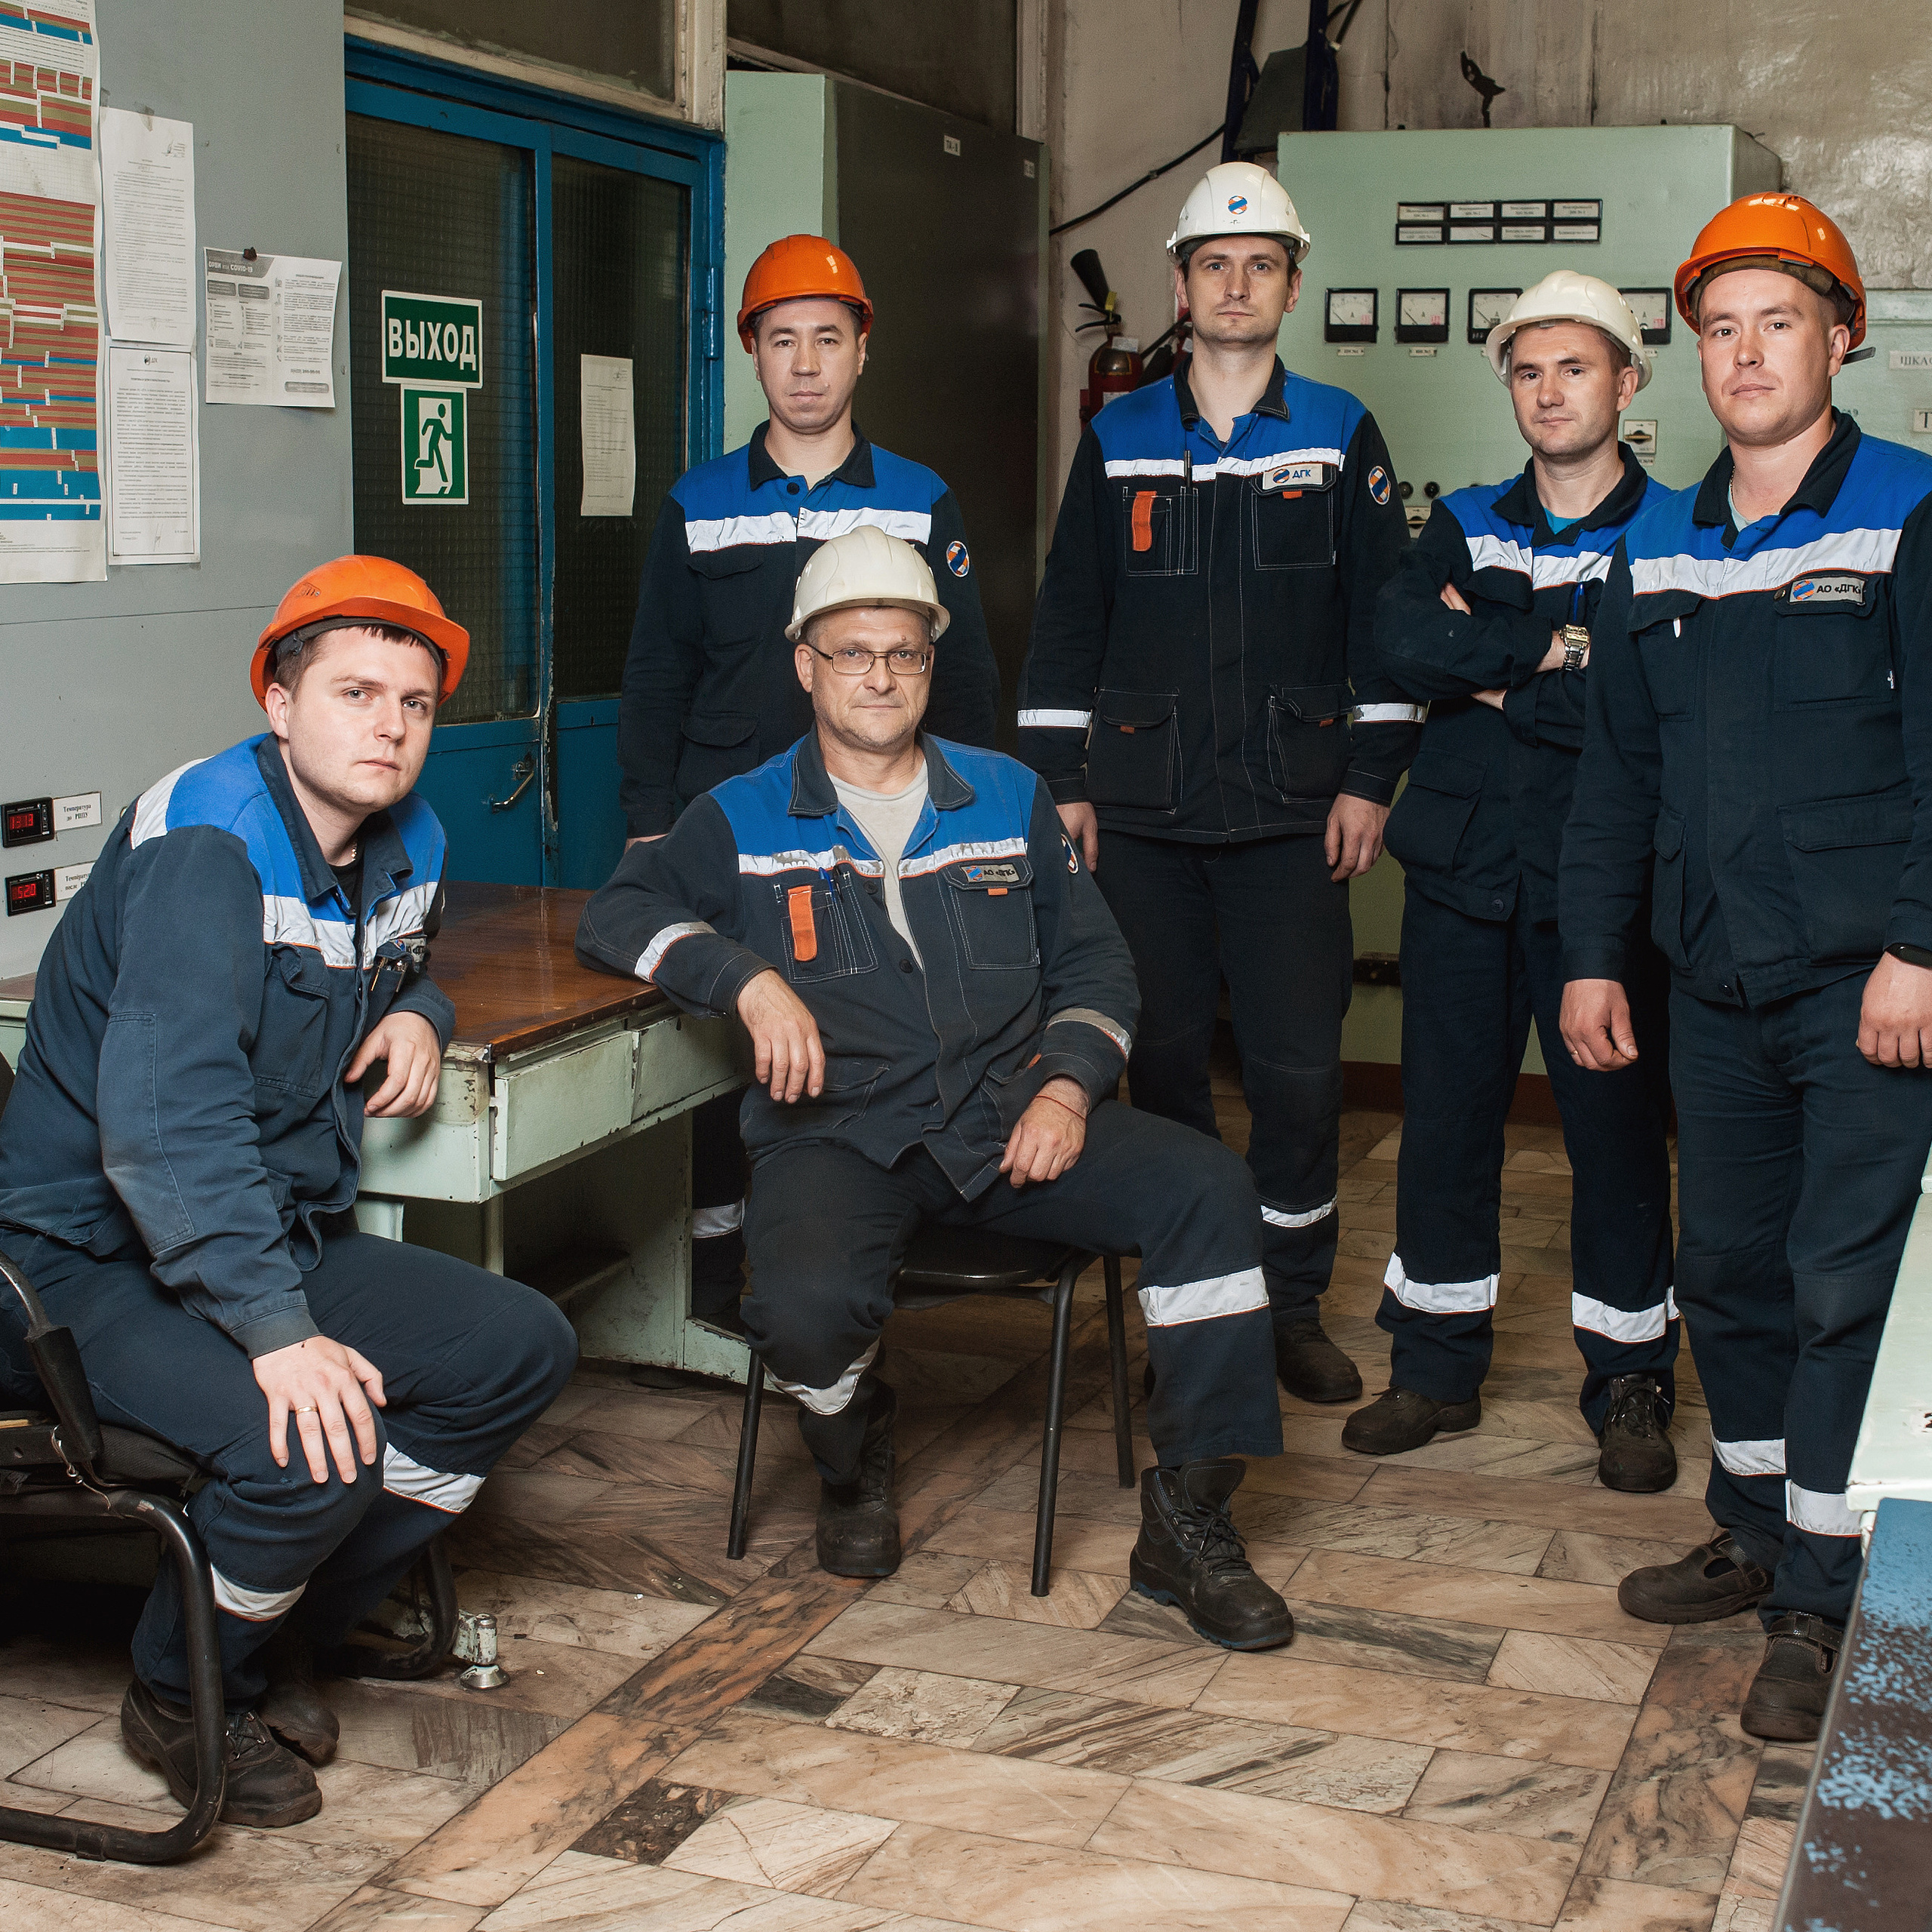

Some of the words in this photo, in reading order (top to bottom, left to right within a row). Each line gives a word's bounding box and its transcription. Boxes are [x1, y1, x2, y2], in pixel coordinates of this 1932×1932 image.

[230, 264, 253, 273] COVID-19
[389, 318, 477, 371] ВЫХОД
[1292, 469, 1311, 478] ДГК
[1817, 585, 1832, 593] АО
[63, 804, 91, 813] Температура
[65, 873, 88, 881] Температу
